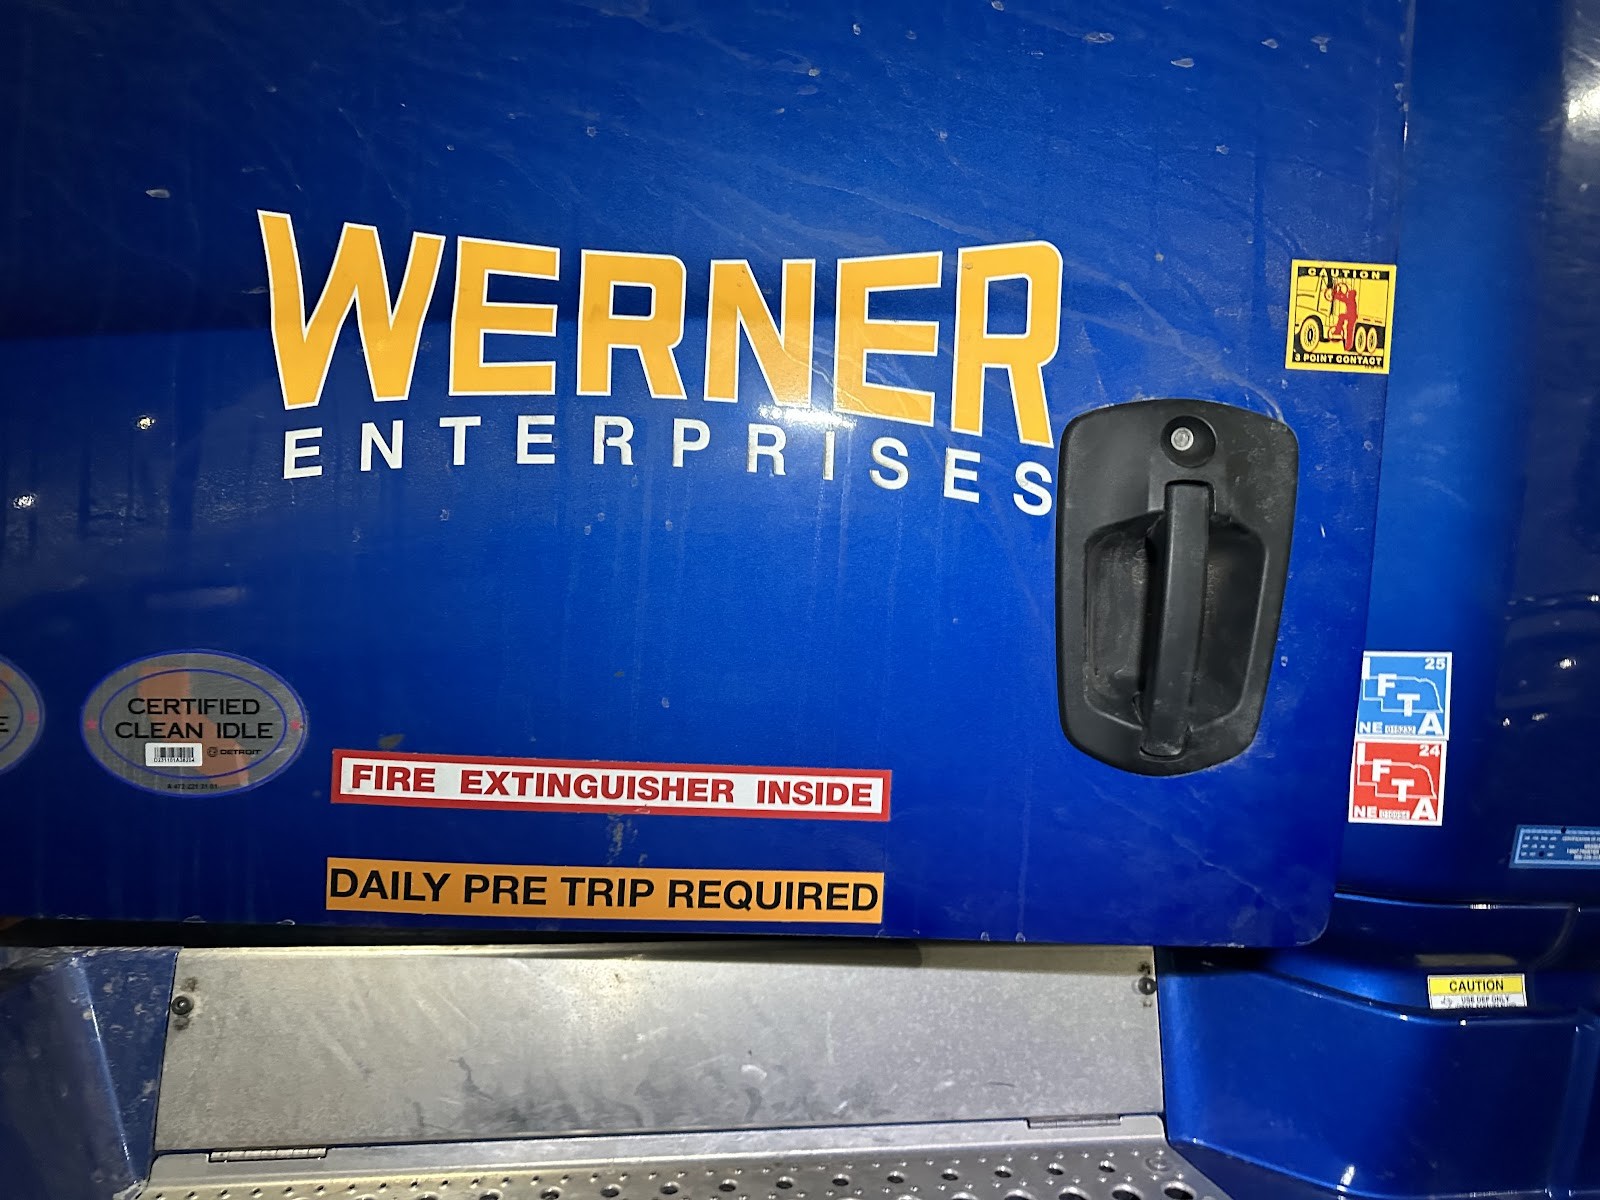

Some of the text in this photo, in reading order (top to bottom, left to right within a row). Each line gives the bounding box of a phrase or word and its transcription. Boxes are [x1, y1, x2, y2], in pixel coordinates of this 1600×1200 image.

[1307, 267, 1381, 279] CAUTION
[257, 209, 1063, 449] WERNER
[1294, 353, 1382, 365] 3 POINT CONTACT
[282, 414, 1054, 517] ENTERPRISES
[1424, 657, 1446, 670] 25
[127, 697, 261, 716] CERTIFIED
[114, 721, 274, 739] CLEAN IDLE
[1358, 721, 1383, 734] NE
[1418, 744, 1441, 757] 24
[351, 764, 873, 808] FIRE EXTINGUISHER INSIDE
[1353, 805, 1378, 819] NE
[329, 868, 880, 913] DAILY PRE TRIP REQUIRED
[1449, 980, 1504, 992] CAUTION
